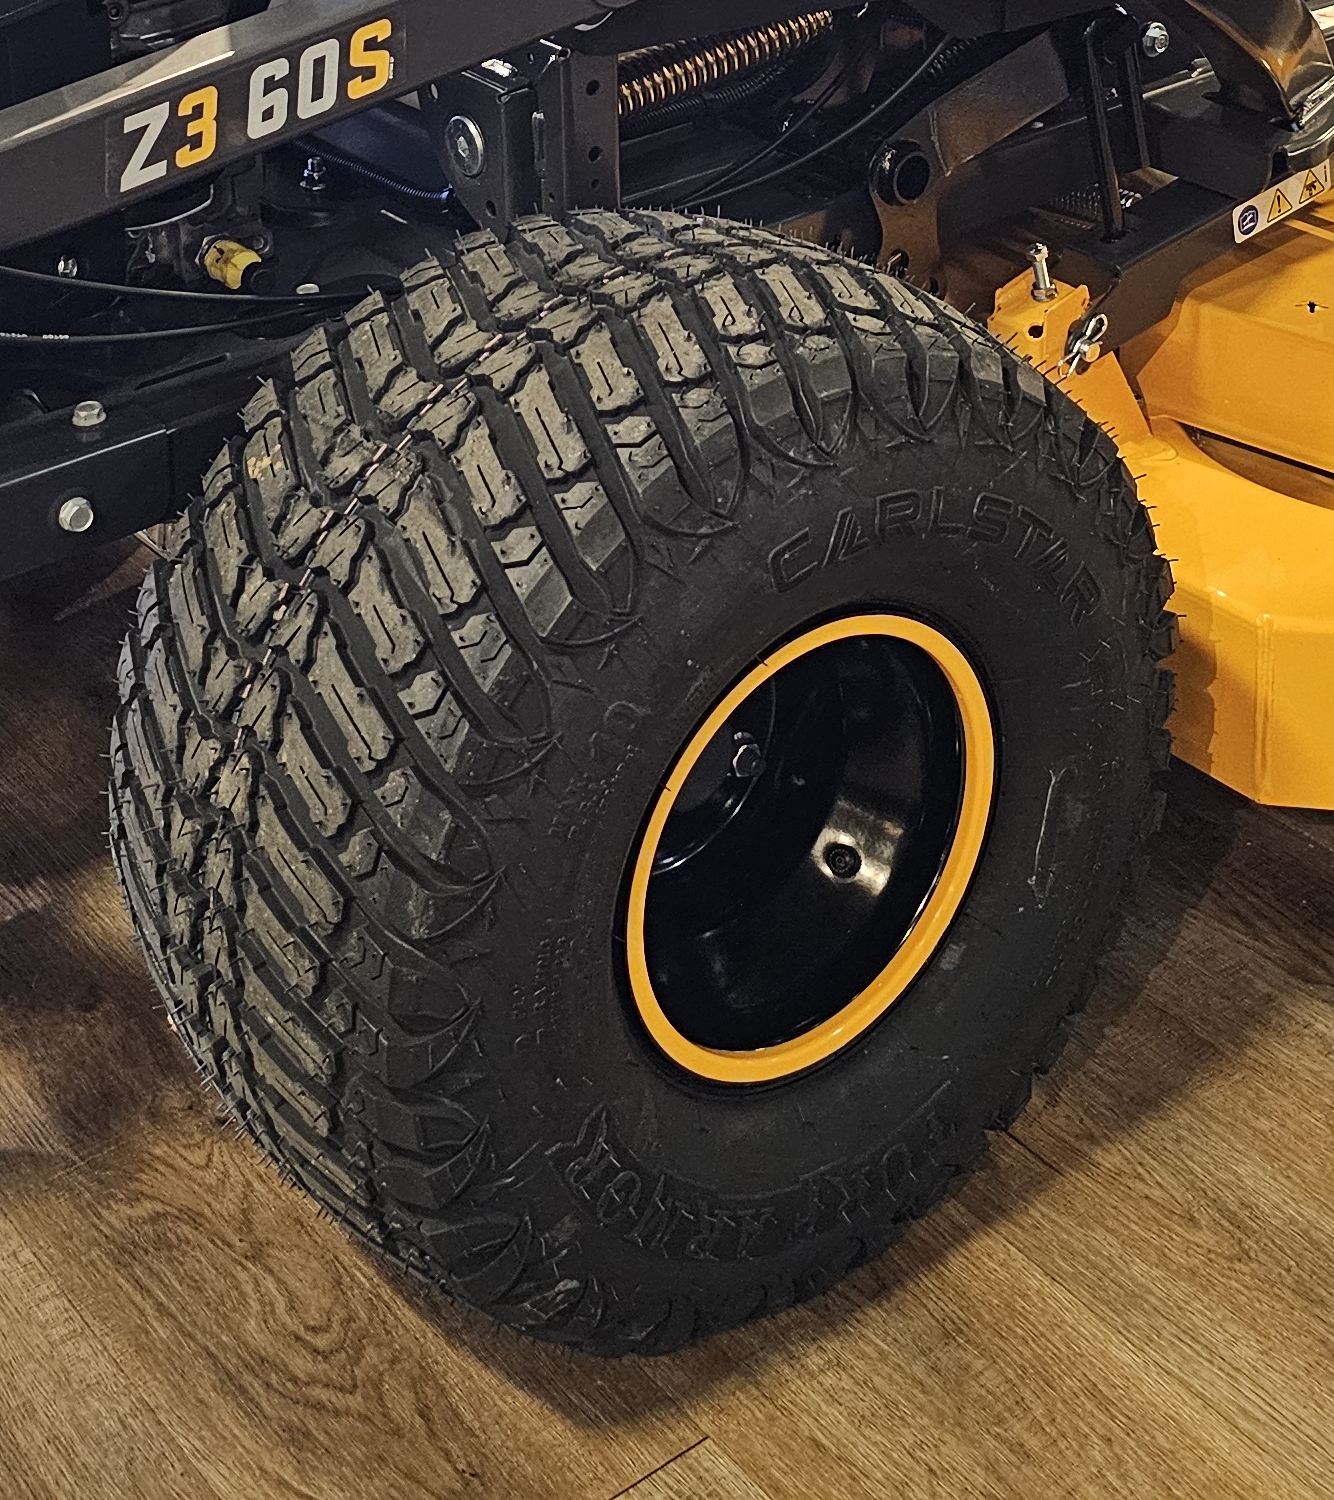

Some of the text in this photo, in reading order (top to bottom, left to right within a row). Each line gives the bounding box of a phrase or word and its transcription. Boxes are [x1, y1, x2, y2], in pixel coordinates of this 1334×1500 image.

[120, 19, 393, 193] Z3 60S
[768, 486, 1103, 631] CARLSTAR
